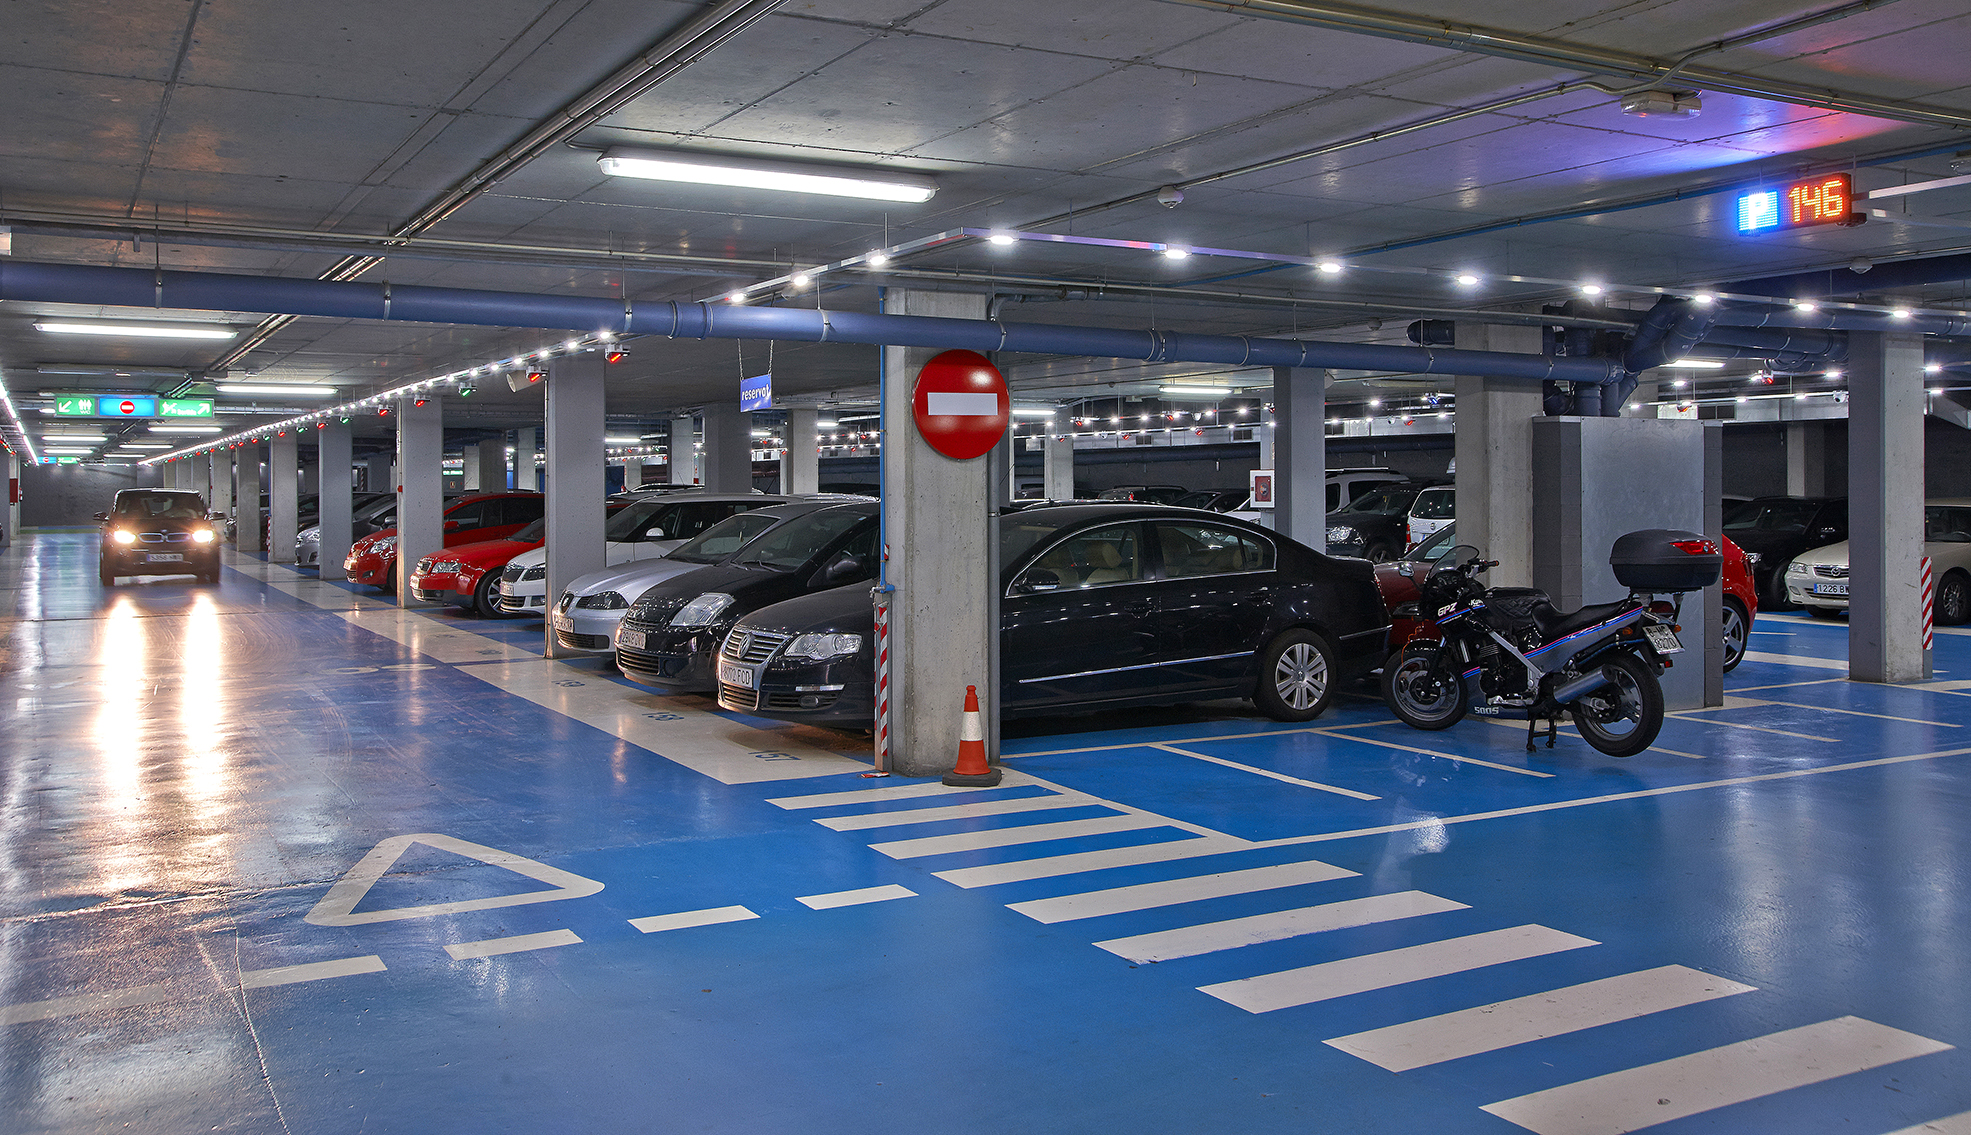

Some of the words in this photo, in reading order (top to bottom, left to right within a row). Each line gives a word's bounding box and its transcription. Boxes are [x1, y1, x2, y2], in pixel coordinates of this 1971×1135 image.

[1748, 192, 1768, 230] P
[1788, 180, 1843, 222] 146
[1818, 584, 1838, 593] 1226
[1437, 601, 1458, 617] GPZ
[1474, 706, 1499, 715] 500S
[748, 750, 802, 762] 157
